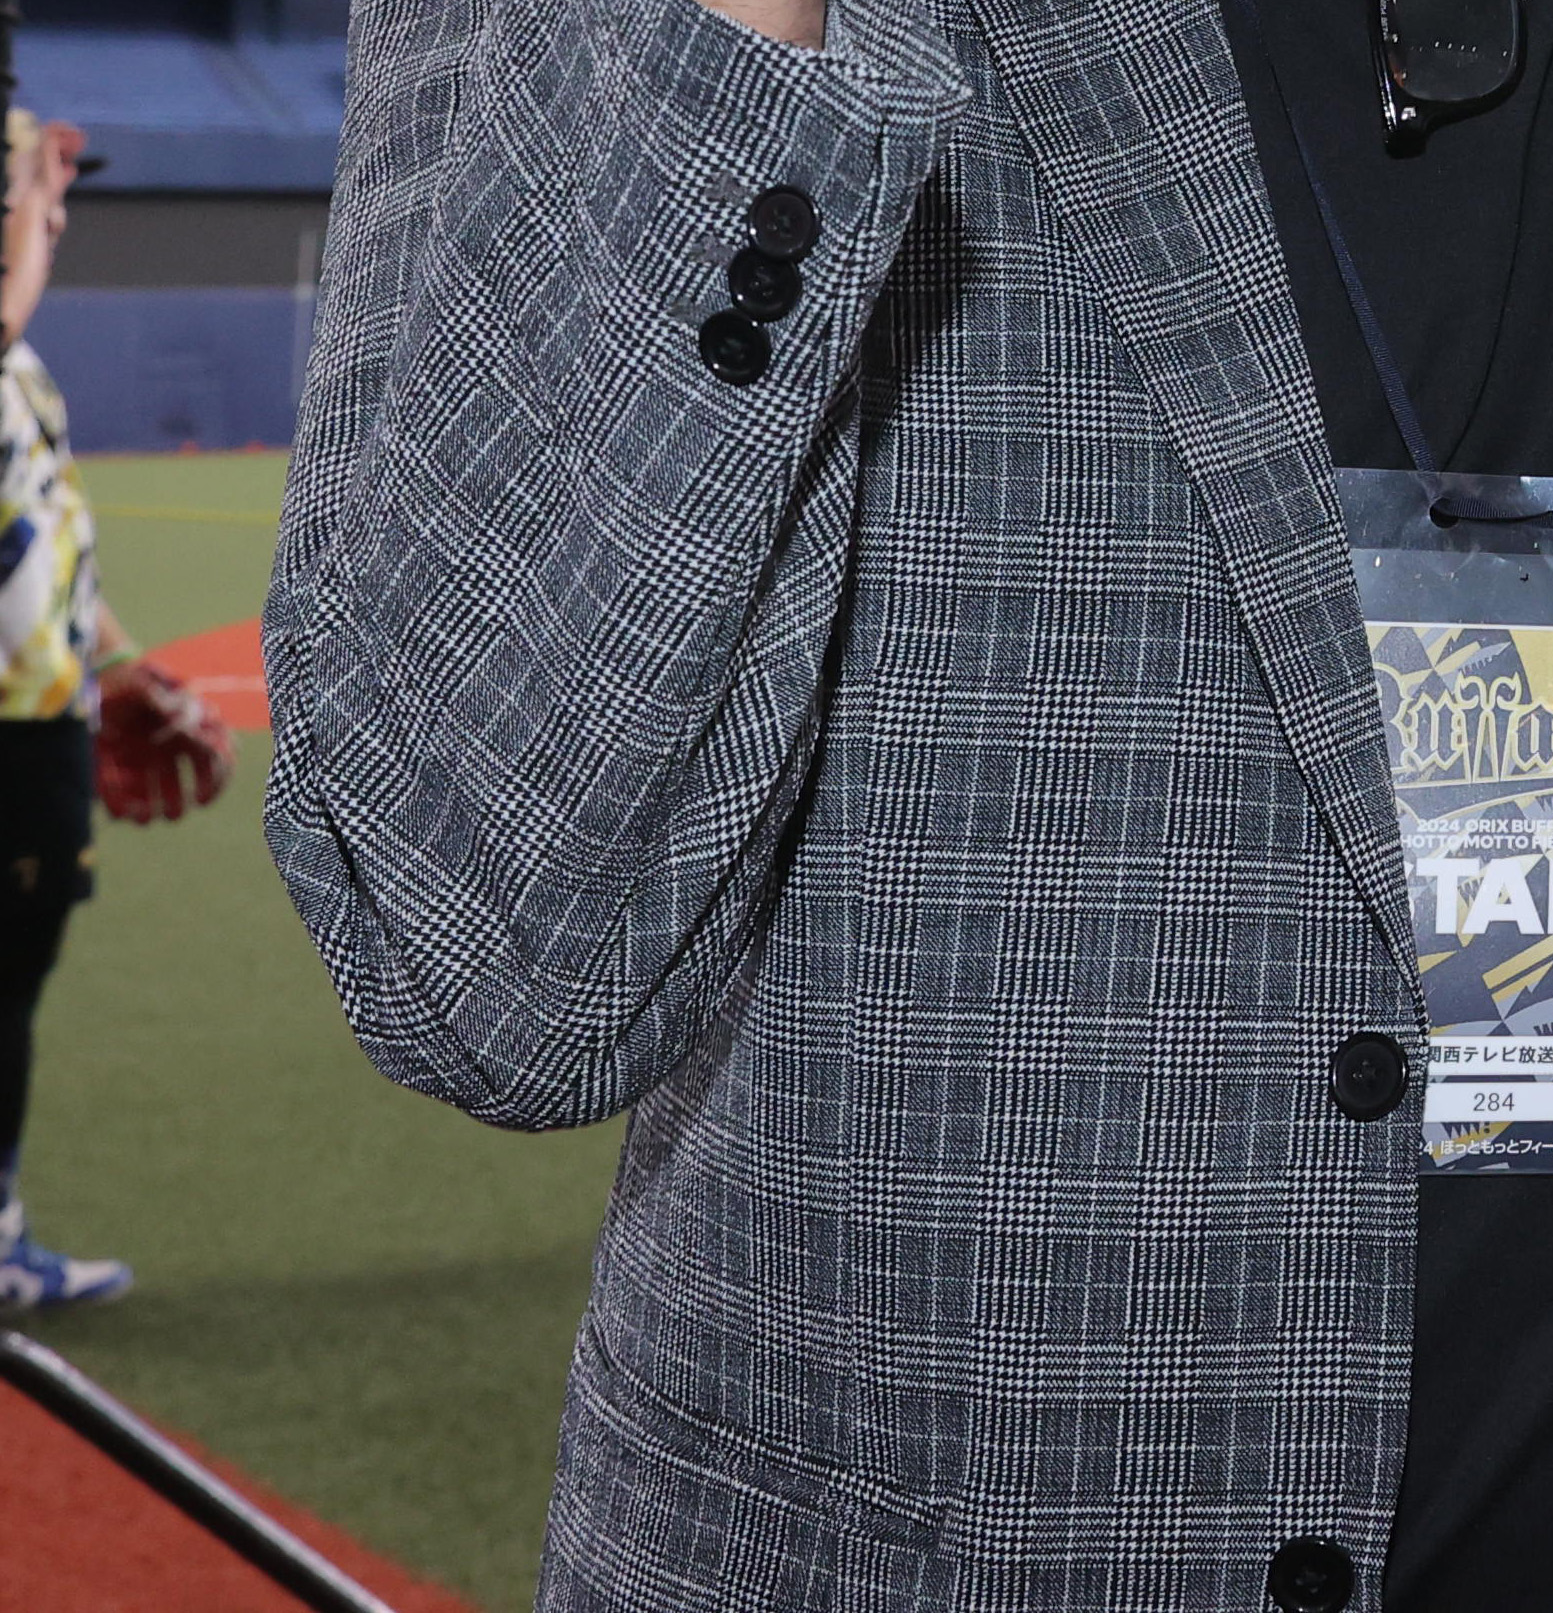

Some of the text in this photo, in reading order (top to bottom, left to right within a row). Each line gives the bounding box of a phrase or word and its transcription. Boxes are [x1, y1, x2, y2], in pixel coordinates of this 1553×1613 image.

[1416, 818, 1461, 834] 2024
[1464, 818, 1510, 834] ORIX
[1400, 834, 1464, 850] HOTTO
[1464, 834, 1529, 850] MOTTO
[1472, 1092, 1516, 1112] 284
